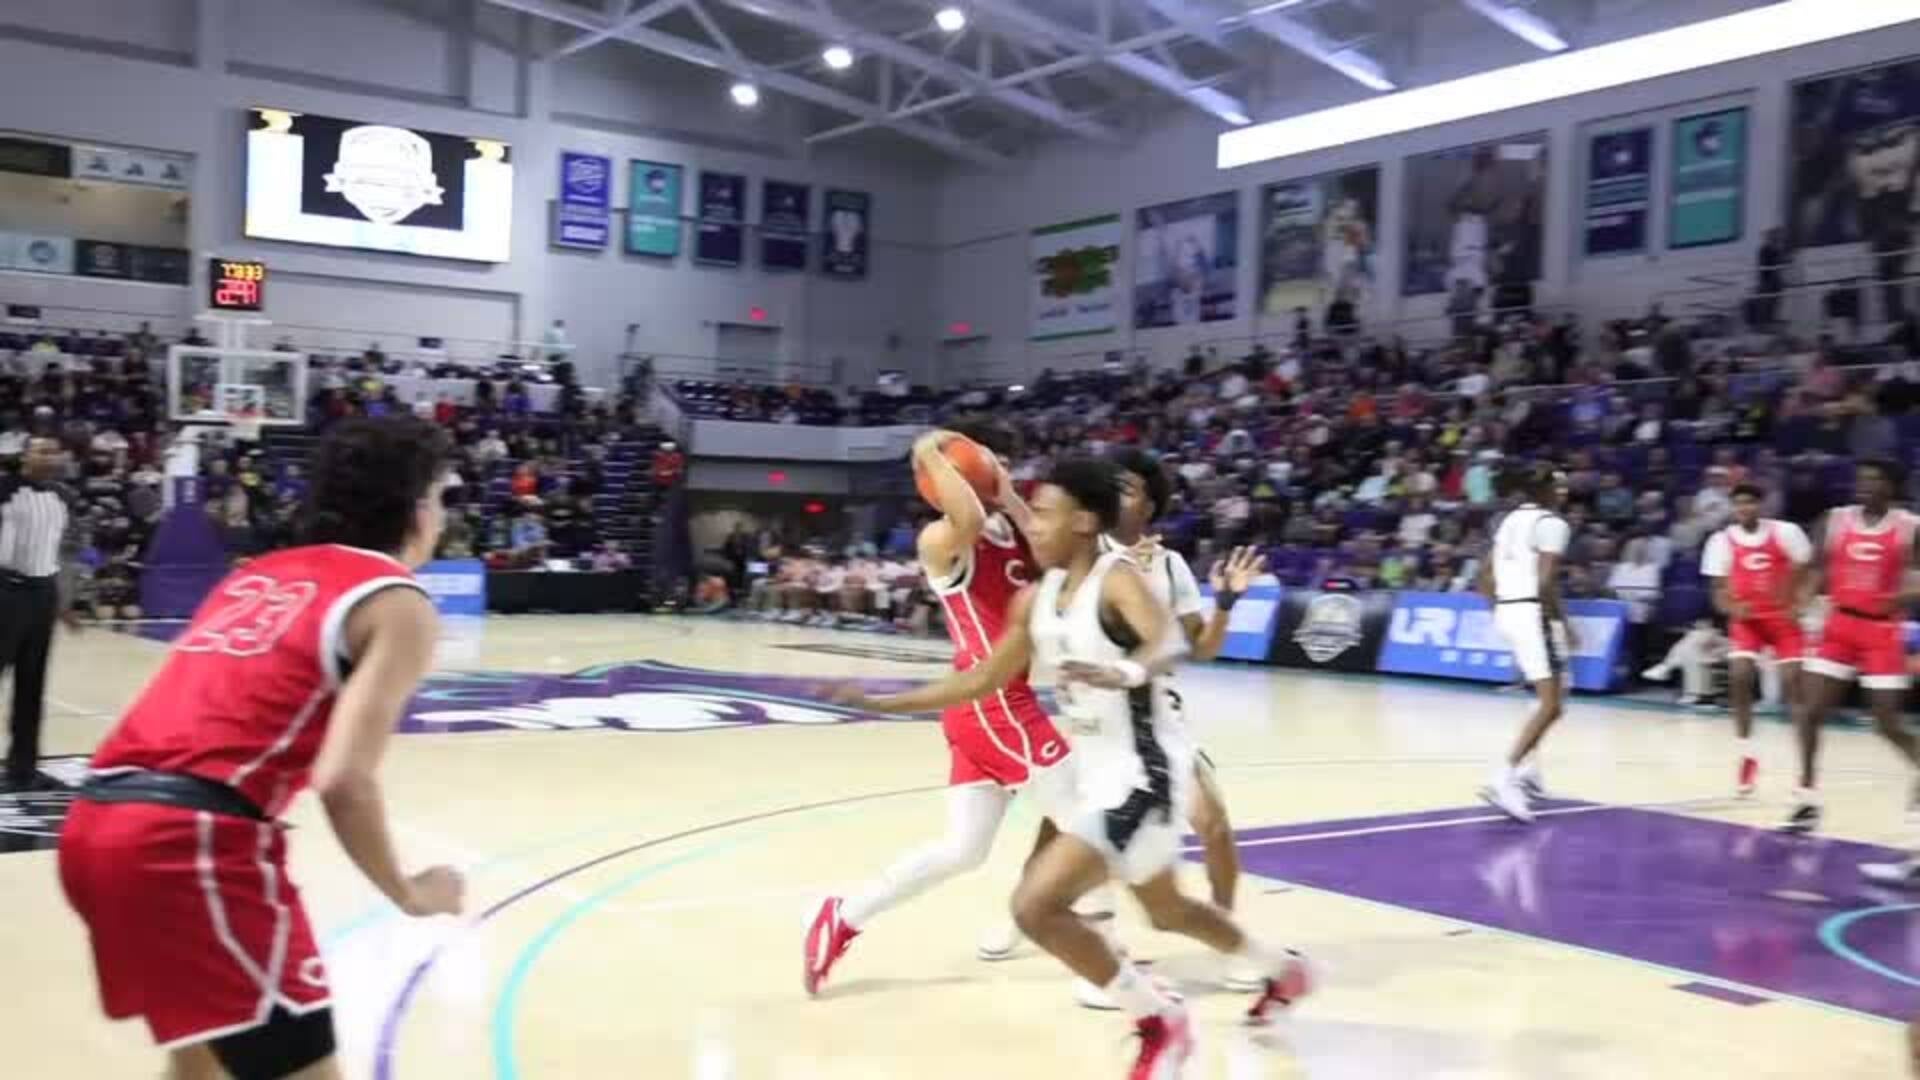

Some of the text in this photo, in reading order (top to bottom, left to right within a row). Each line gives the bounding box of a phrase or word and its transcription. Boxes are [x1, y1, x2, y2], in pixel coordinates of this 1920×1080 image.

[1004, 558, 1031, 587] C
[175, 574, 318, 657] 23
[1040, 740, 1060, 759] C
